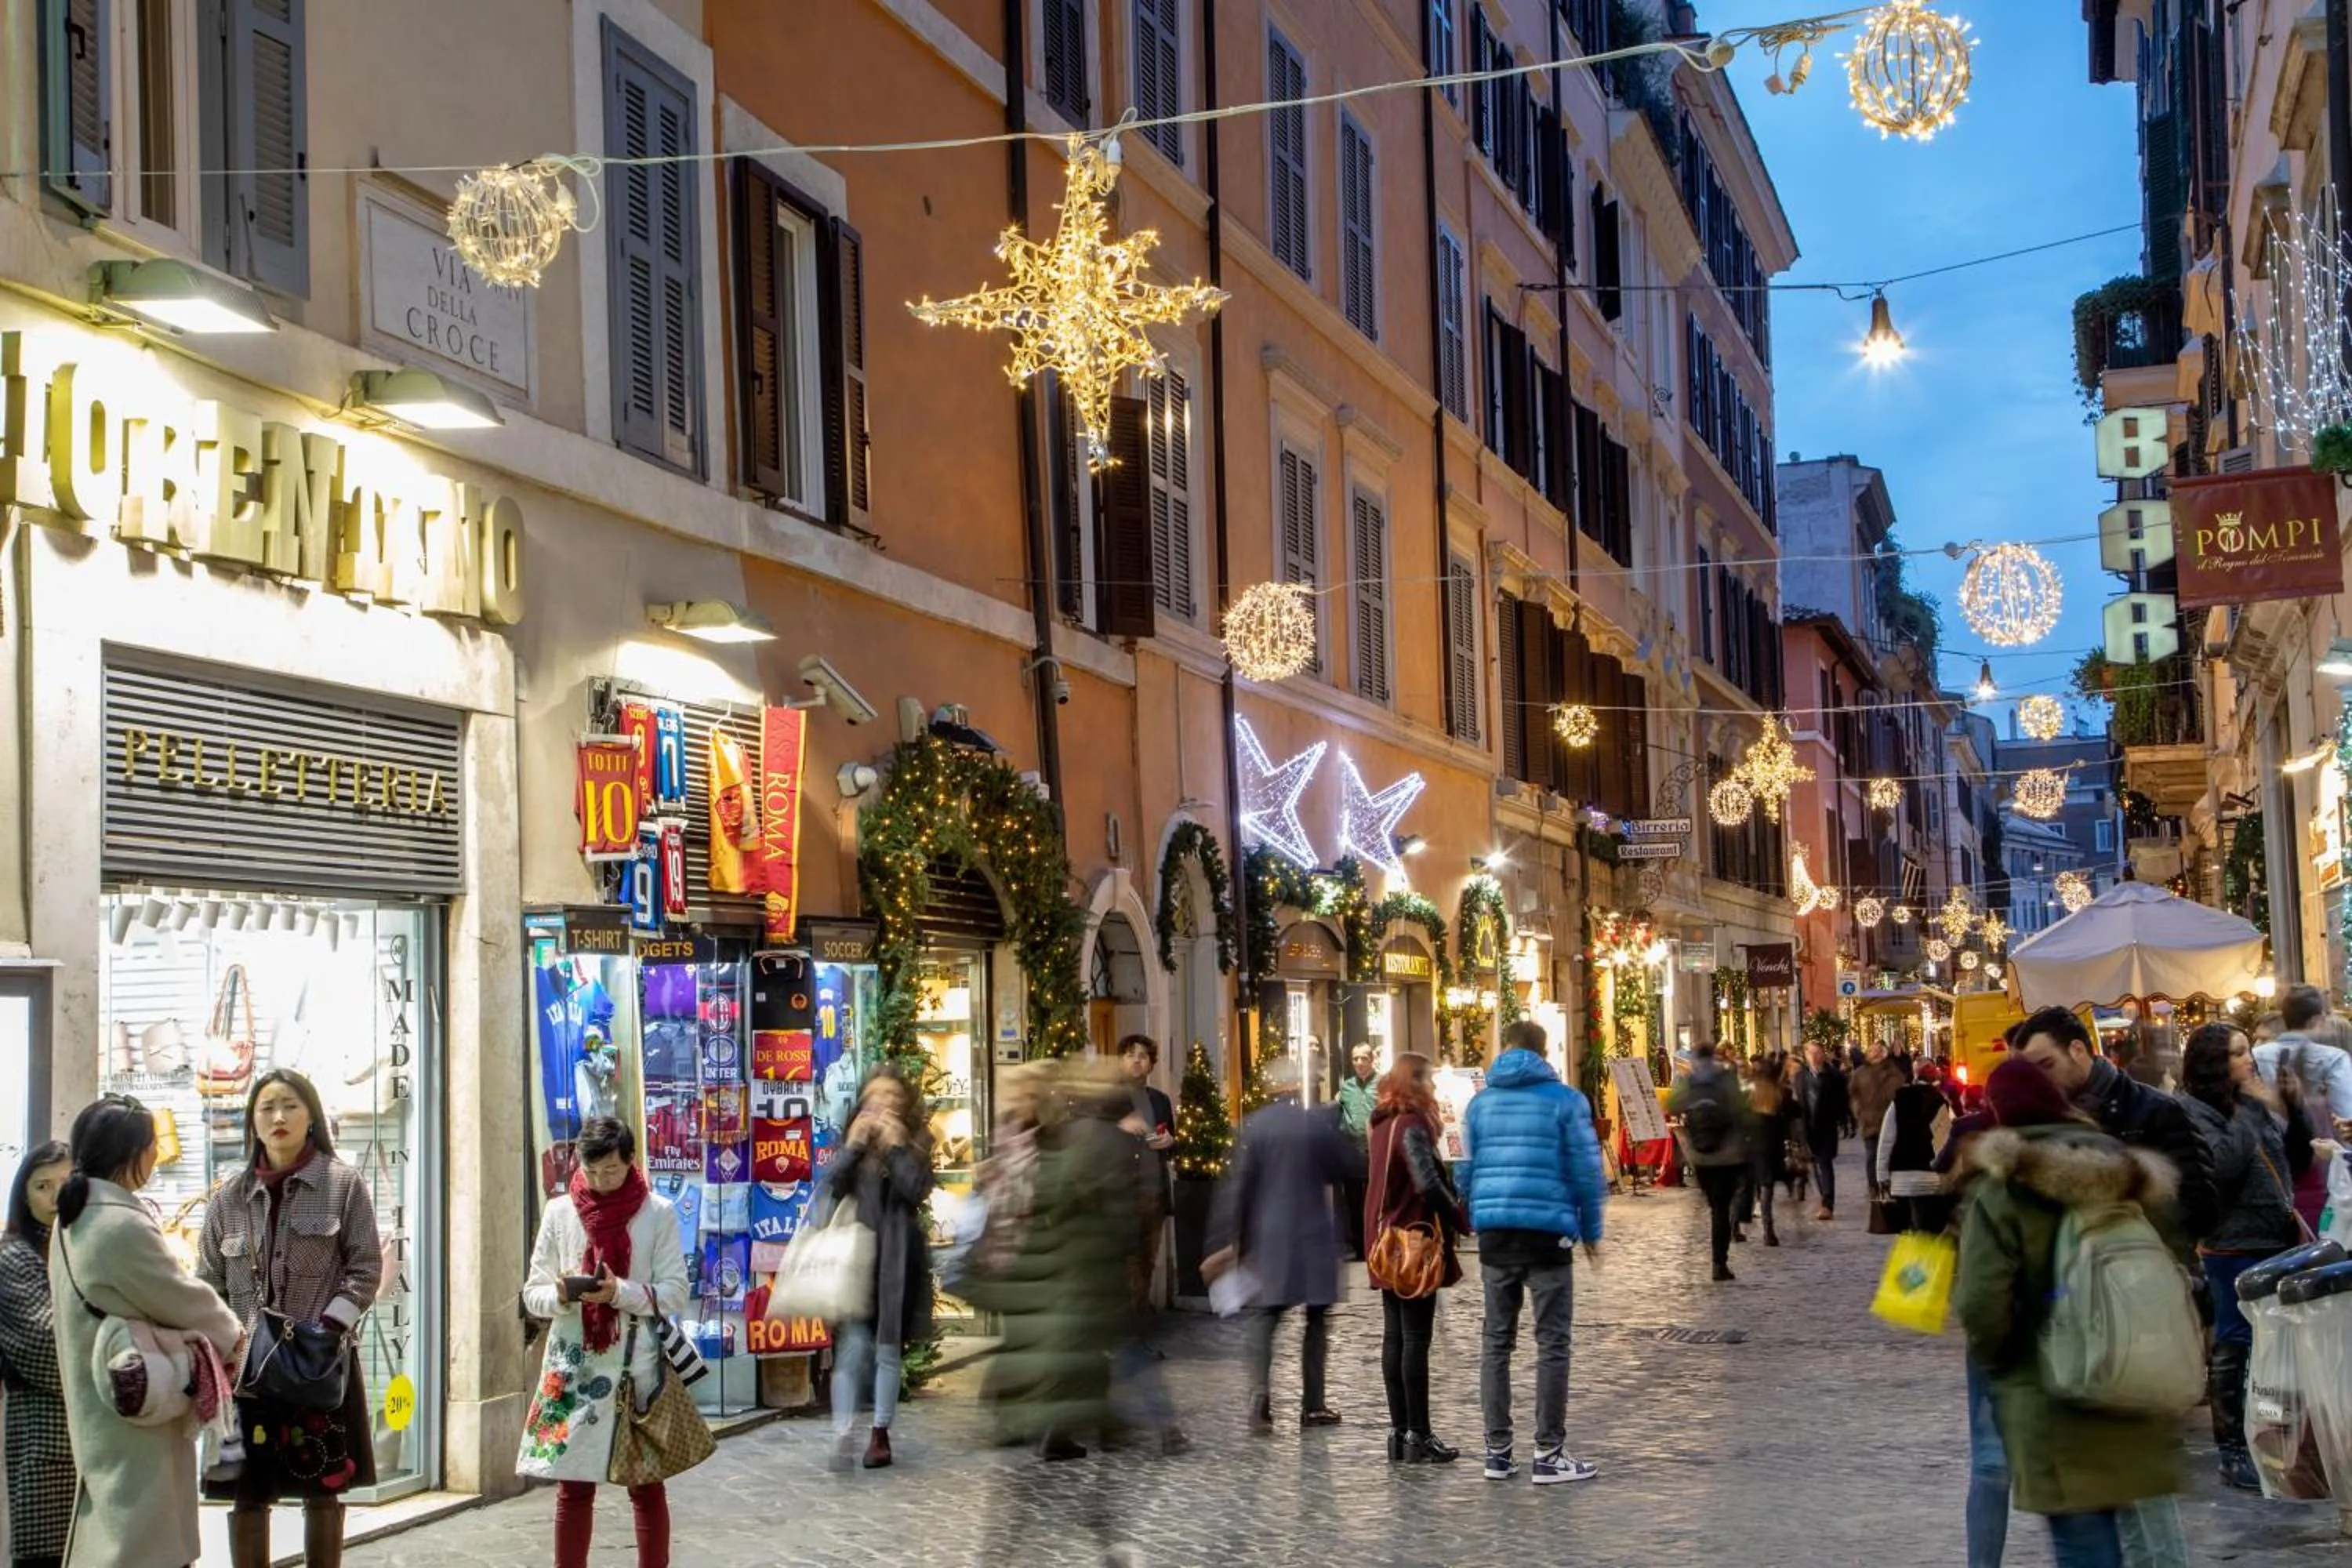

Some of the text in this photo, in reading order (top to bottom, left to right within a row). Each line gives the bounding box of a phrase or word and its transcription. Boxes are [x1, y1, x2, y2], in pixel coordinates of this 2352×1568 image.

[432, 248, 471, 294] VIA
[427, 285, 477, 326] DELLA
[406, 307, 499, 373] CROCE
[2196, 517, 2321, 556] POMPI
[124, 728, 449, 816] PELLETTERIA
[586, 753, 626, 772] TOTTI
[585, 779, 633, 844] 10
[764, 771, 790, 861] ROMA
[1620, 844, 1678, 857] Restaurant
[633, 863, 653, 923] 9
[571, 929, 623, 949] T-SHIRT
[824, 941, 863, 957] SOCCER
[386, 979, 415, 1099] MADE
[757, 1049, 811, 1062] DE ROSSI
[705, 1066, 738, 1080] INTER
[763, 1081, 804, 1094] DYBALA
[391, 1149, 409, 1164] IN
[648, 1156, 700, 1169] Emirates
[664, 1146, 681, 1156] Fly
[755, 1139, 809, 1163] ROMA
[753, 1216, 811, 1240] ITALI
[390, 1205, 412, 1360] ITALY
[749, 1316, 827, 1350] ROMA
[387, 1396, 410, 1414] -20%
